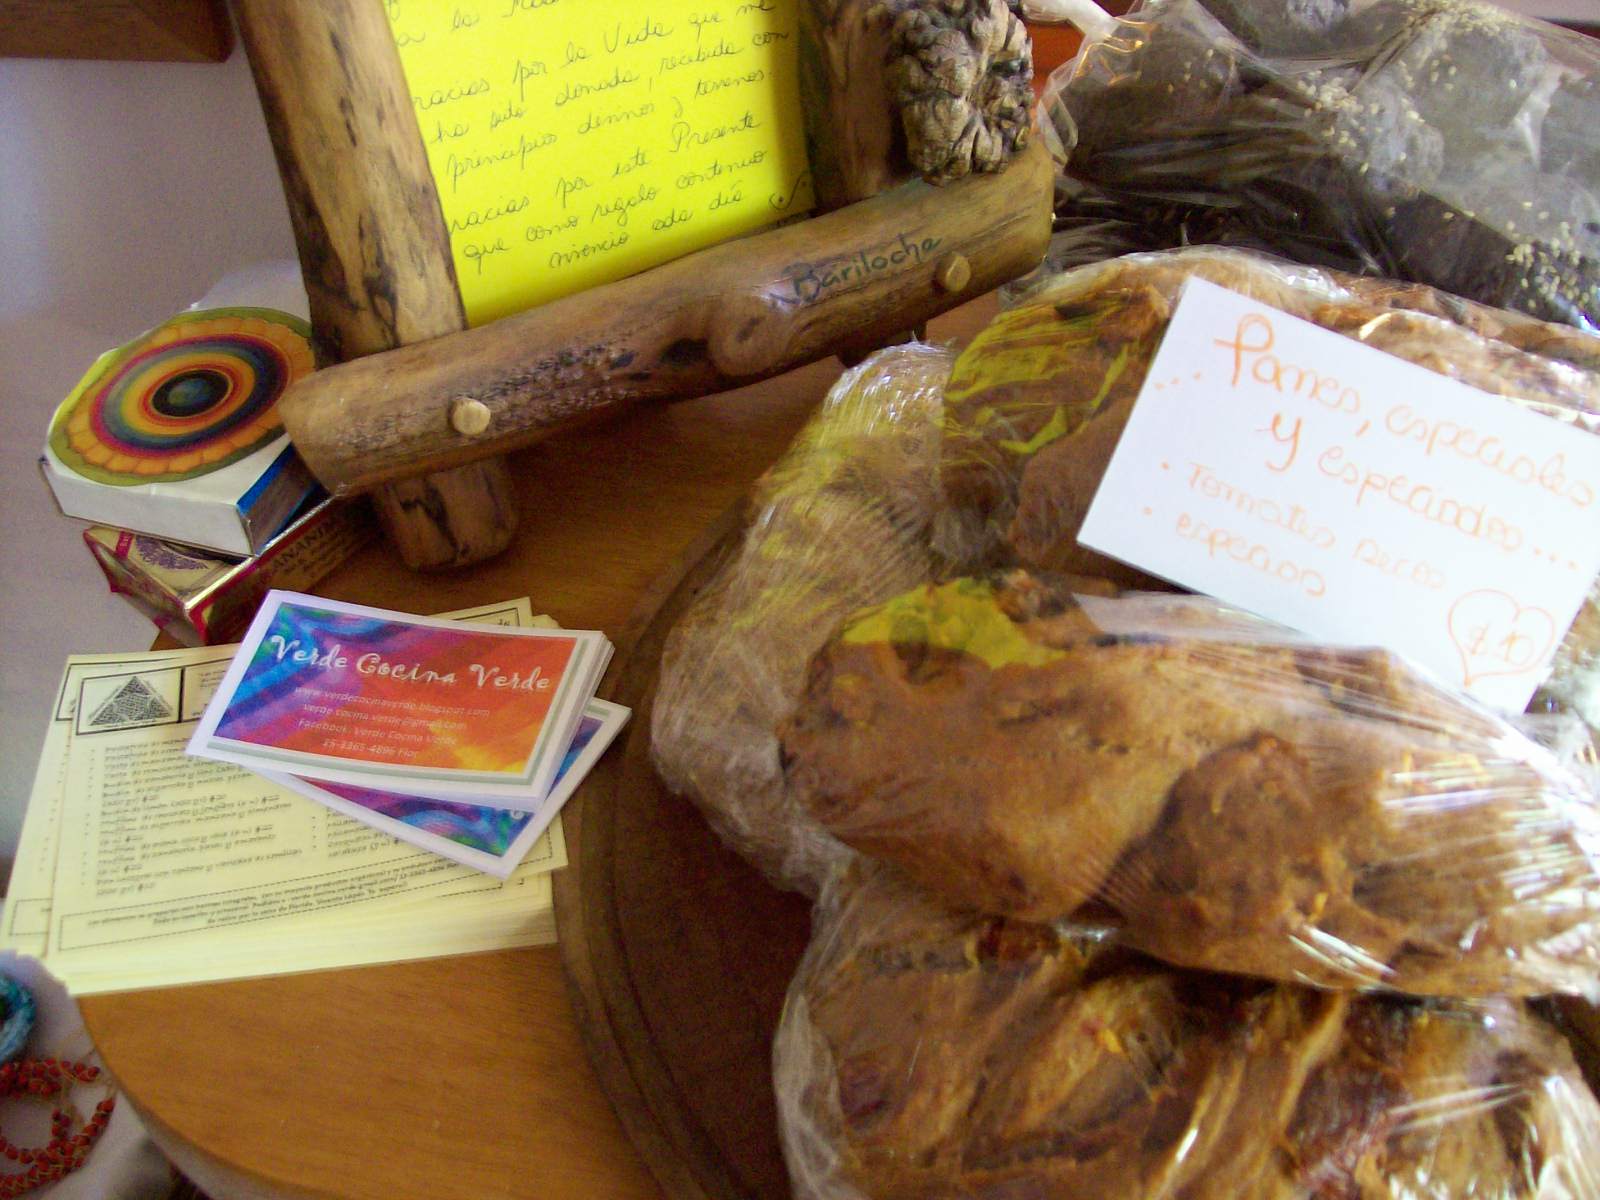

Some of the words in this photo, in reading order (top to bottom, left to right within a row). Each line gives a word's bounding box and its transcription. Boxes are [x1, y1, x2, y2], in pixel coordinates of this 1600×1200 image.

[772, 231, 943, 305] Bariloche
[269, 634, 348, 668] Verde
[356, 652, 457, 686] Cocina
[468, 663, 551, 691] Verde
